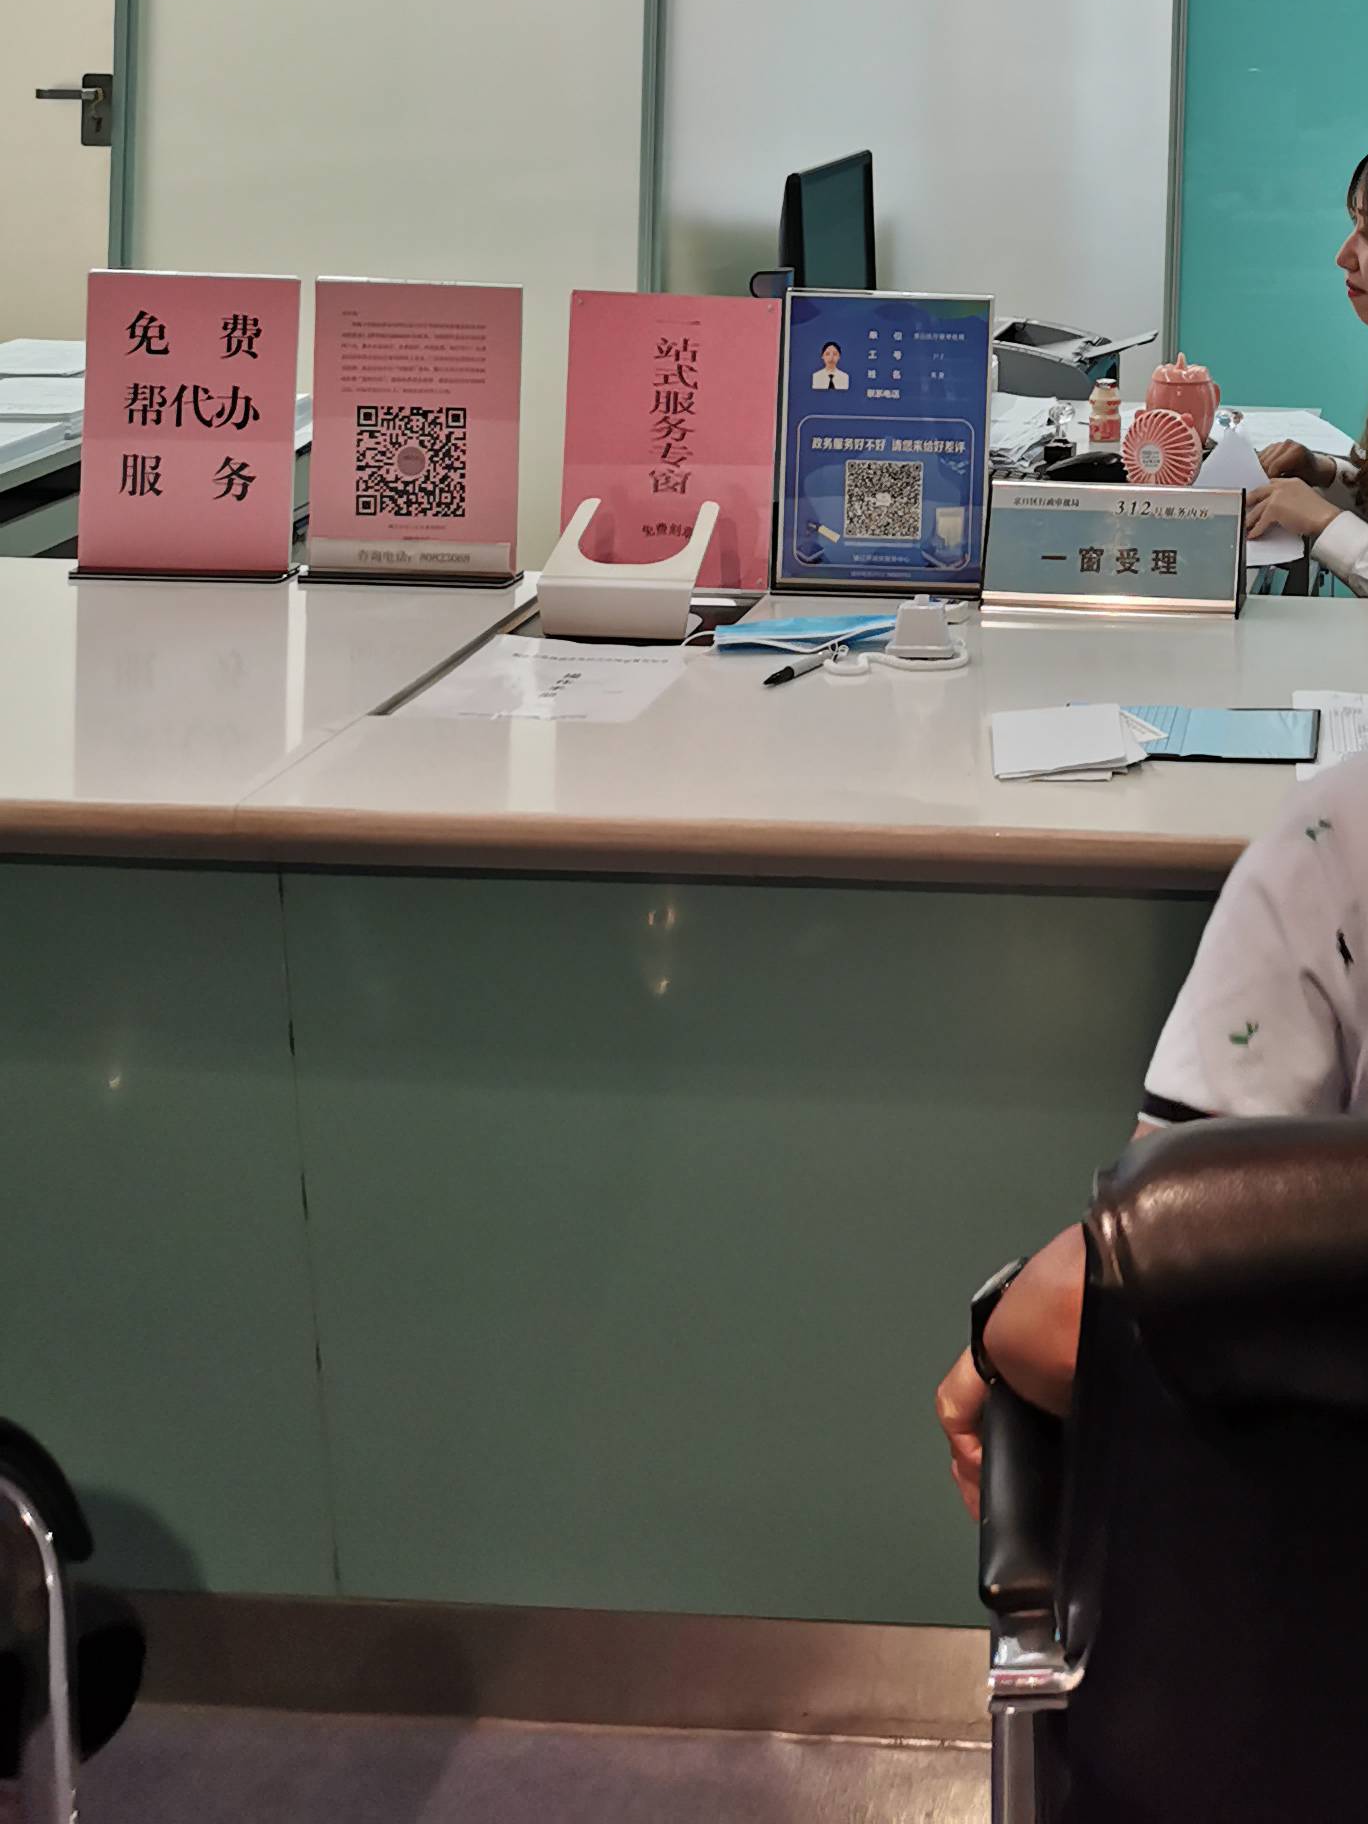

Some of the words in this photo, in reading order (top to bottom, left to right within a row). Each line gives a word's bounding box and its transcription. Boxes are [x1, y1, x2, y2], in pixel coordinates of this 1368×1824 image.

[125, 310, 263, 360] 免费
[124, 383, 261, 431] 帮代办
[648, 320, 700, 495] 一站式服务专窗
[812, 437, 886, 452] 政务服务好不好
[119, 453, 256, 501] 服务
[1041, 546, 1178, 574] 一窗受理
